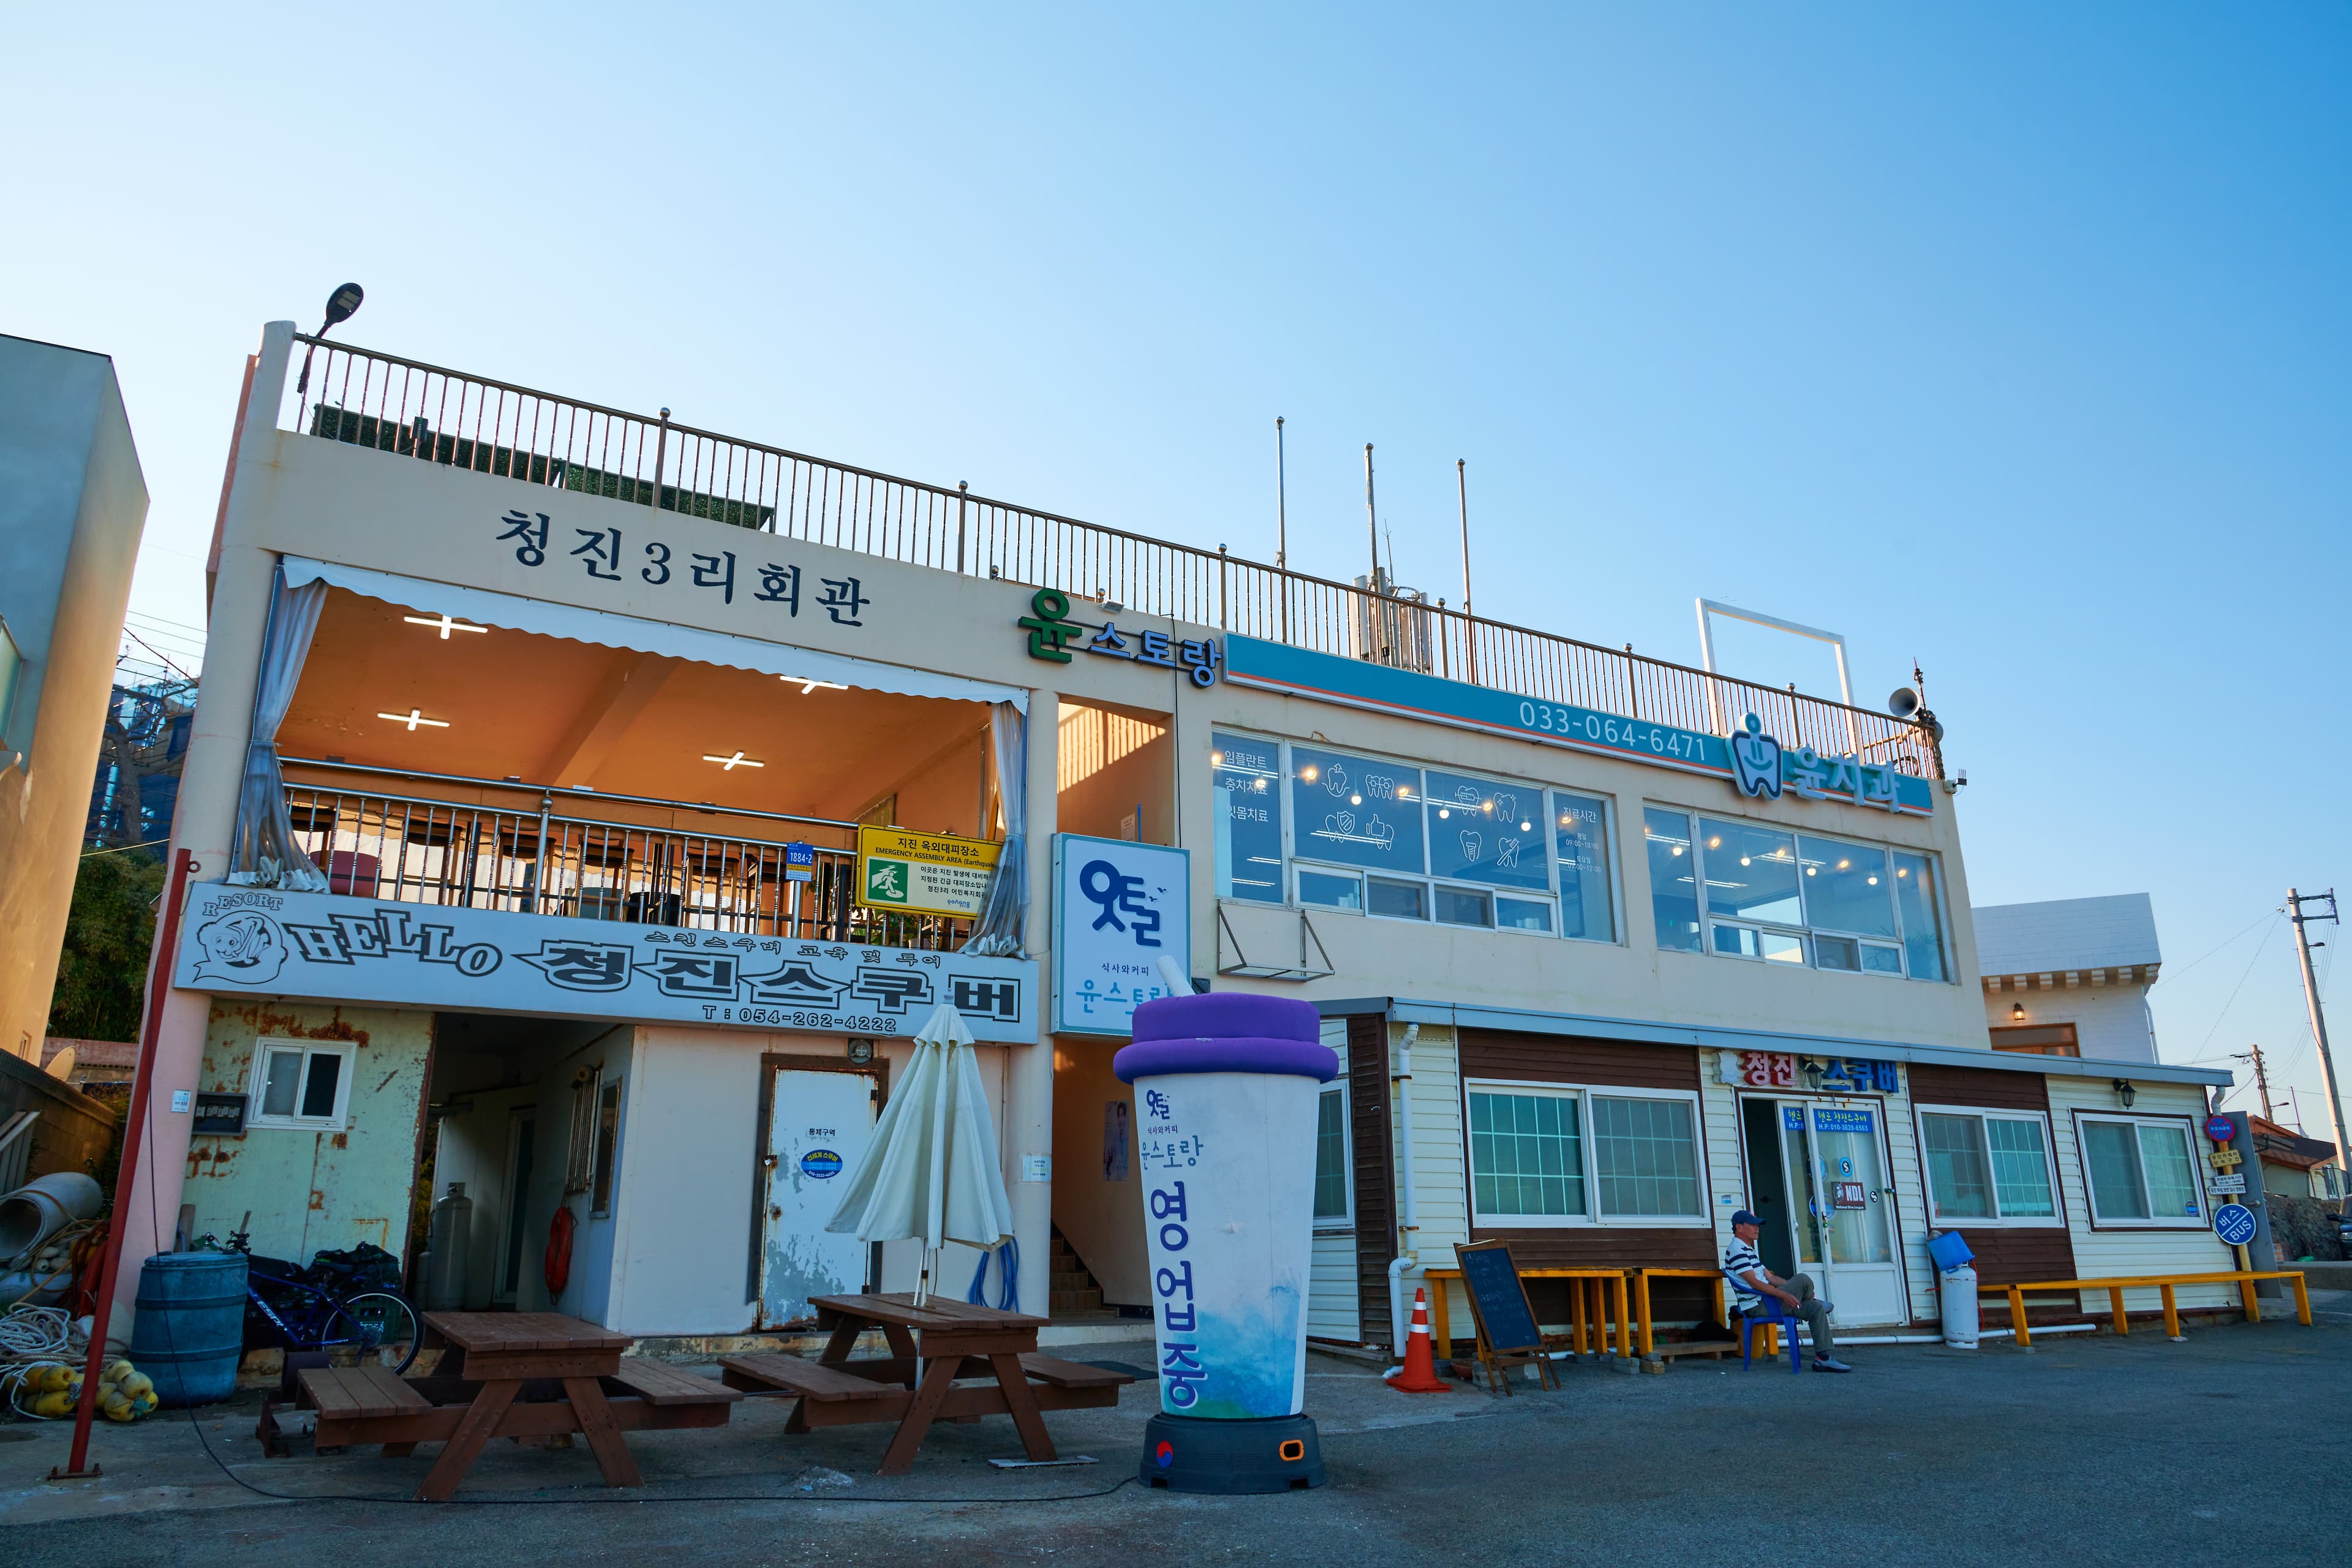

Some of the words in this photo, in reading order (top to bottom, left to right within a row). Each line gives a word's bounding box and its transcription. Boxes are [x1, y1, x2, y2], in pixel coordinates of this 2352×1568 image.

[496, 509, 870, 627] 청진3리회관
[1018, 587, 1223, 688] 윤스토랑
[1520, 701, 1705, 761] 033-064-6471
[1225, 750, 1267, 769] 임플란트
[1225, 777, 1267, 795] 충치치료
[1788, 742, 1901, 814] 윤치과
[1226, 805, 1268, 823] 잇몸치료
[790, 852, 812, 864] 1884-2
[875, 847, 913, 858] EMERGENCY
[914, 851, 945, 862] ASSEMBLY
[964, 859, 997, 869] (Earthquak
[898, 837, 917, 850] 지진
[921, 840, 979, 857] 옥외대피장소
[953, 880, 987, 889] 대피장소입니
[203, 892, 284, 916] RESORT
[282, 908, 502, 976] HELLO
[797, 945, 848, 960] 교육
[861, 950, 881, 963] 및
[896, 953, 941, 968] 투어
[1102, 962, 1149, 976] 식사와커피
[739, 1008, 897, 1033] 054-262-4222
[1741, 1051, 1796, 1087] 청진
[1822, 1056, 1899, 1095] 스쿠버
[1817, 1110, 1833, 1123] 헬로
[809, 1128, 835, 1137] 통제구역
[1147, 1125, 1178, 1135] 식사와커피
[1141, 1134, 1204, 1170] 윤스토랑
[1845, 1185, 1864, 1202] NDL
[2218, 1209, 2240, 1226] 버스
[2230, 1219, 2252, 1241] BUS
[1150, 1180, 1207, 1408] 영업중
